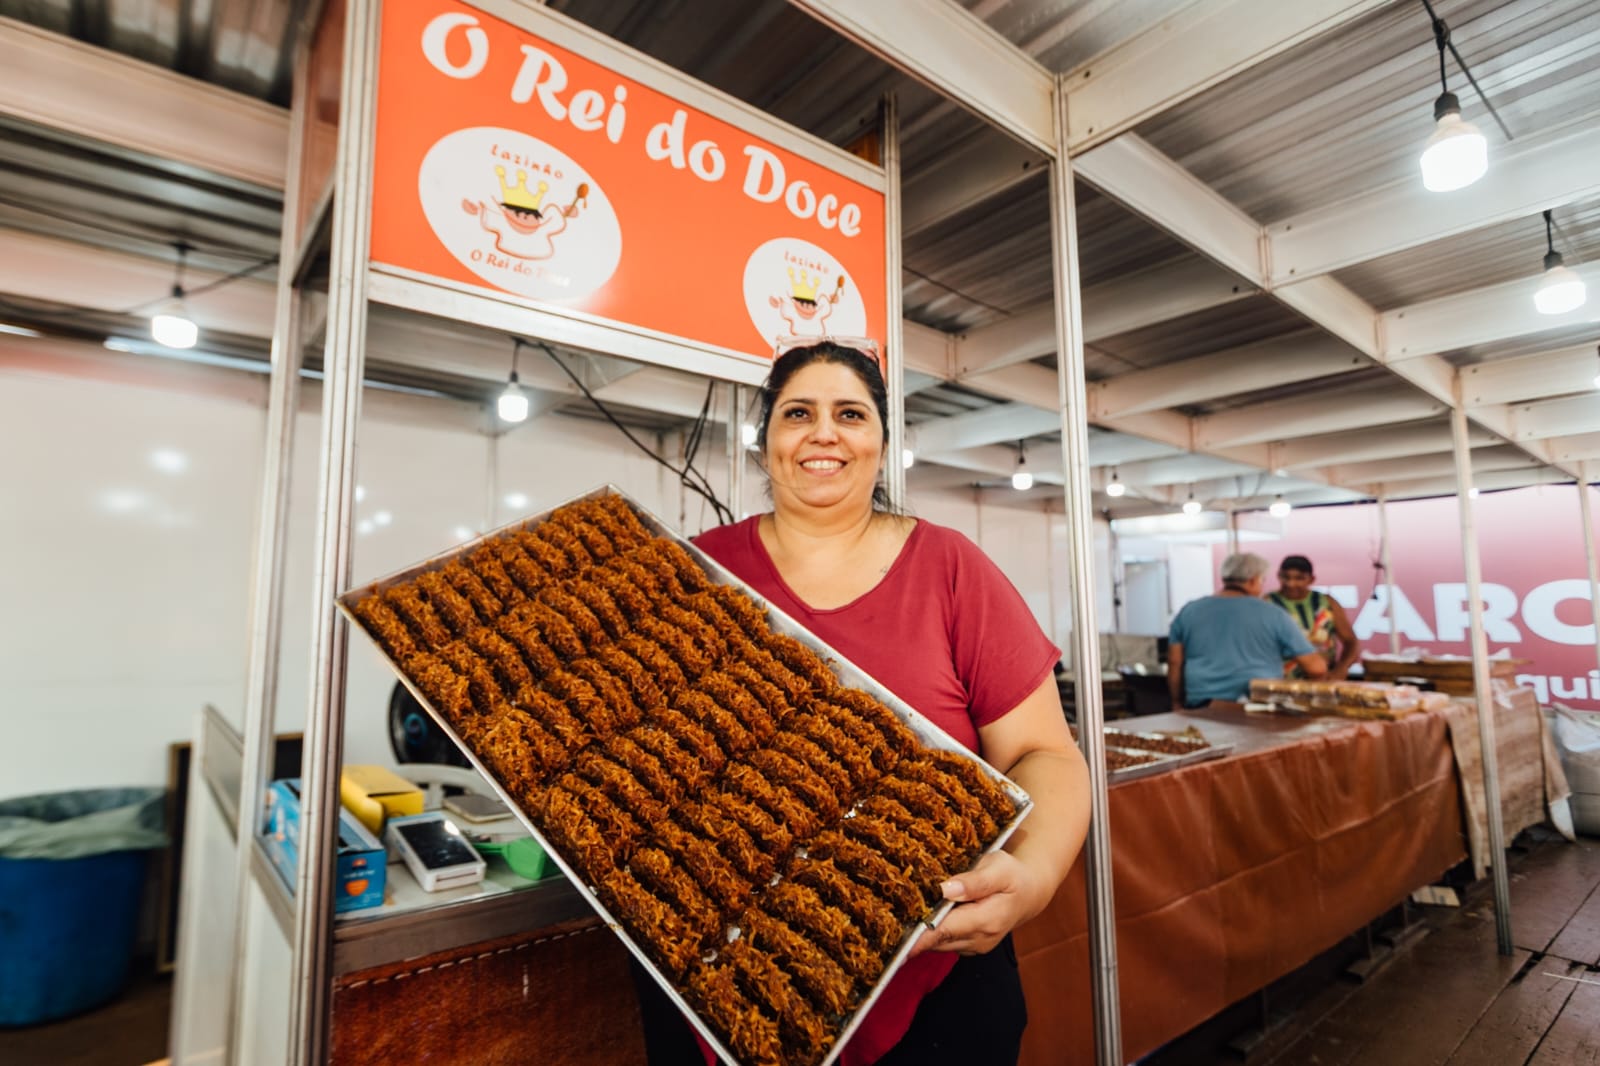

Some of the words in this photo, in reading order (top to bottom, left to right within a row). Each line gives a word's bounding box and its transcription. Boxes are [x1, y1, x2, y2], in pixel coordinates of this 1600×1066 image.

[421, 12, 489, 79] O
[511, 44, 627, 143] Rei
[645, 110, 726, 182] do
[743, 145, 861, 237] Doce
[470, 249, 483, 262] O
[486, 253, 510, 270] Rei
[513, 261, 533, 278] do
